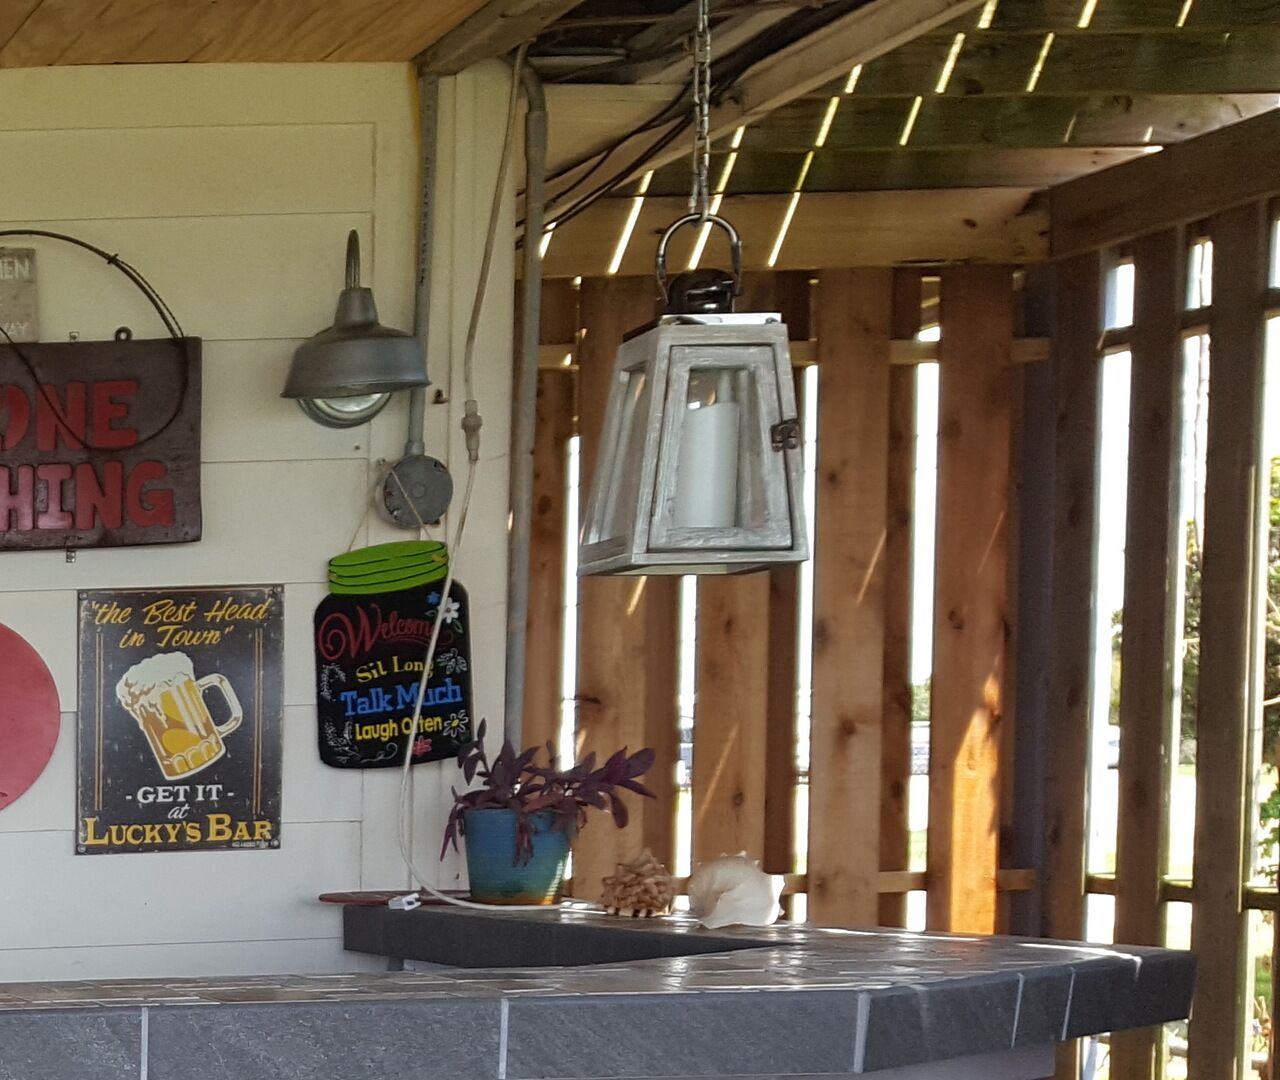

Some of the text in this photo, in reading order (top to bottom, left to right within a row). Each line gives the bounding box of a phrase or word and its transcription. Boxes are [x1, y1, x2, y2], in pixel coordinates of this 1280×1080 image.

[142, 599, 197, 625] Best
[119, 628, 145, 649] in
[319, 603, 454, 660] Welcom
[356, 660, 388, 683] Sit
[340, 677, 463, 716] Talk Much
[355, 716, 442, 742] Laugh Oten
[137, 785, 223, 804] GET IT
[168, 804, 190, 820] at
[206, 813, 273, 842] BAR
